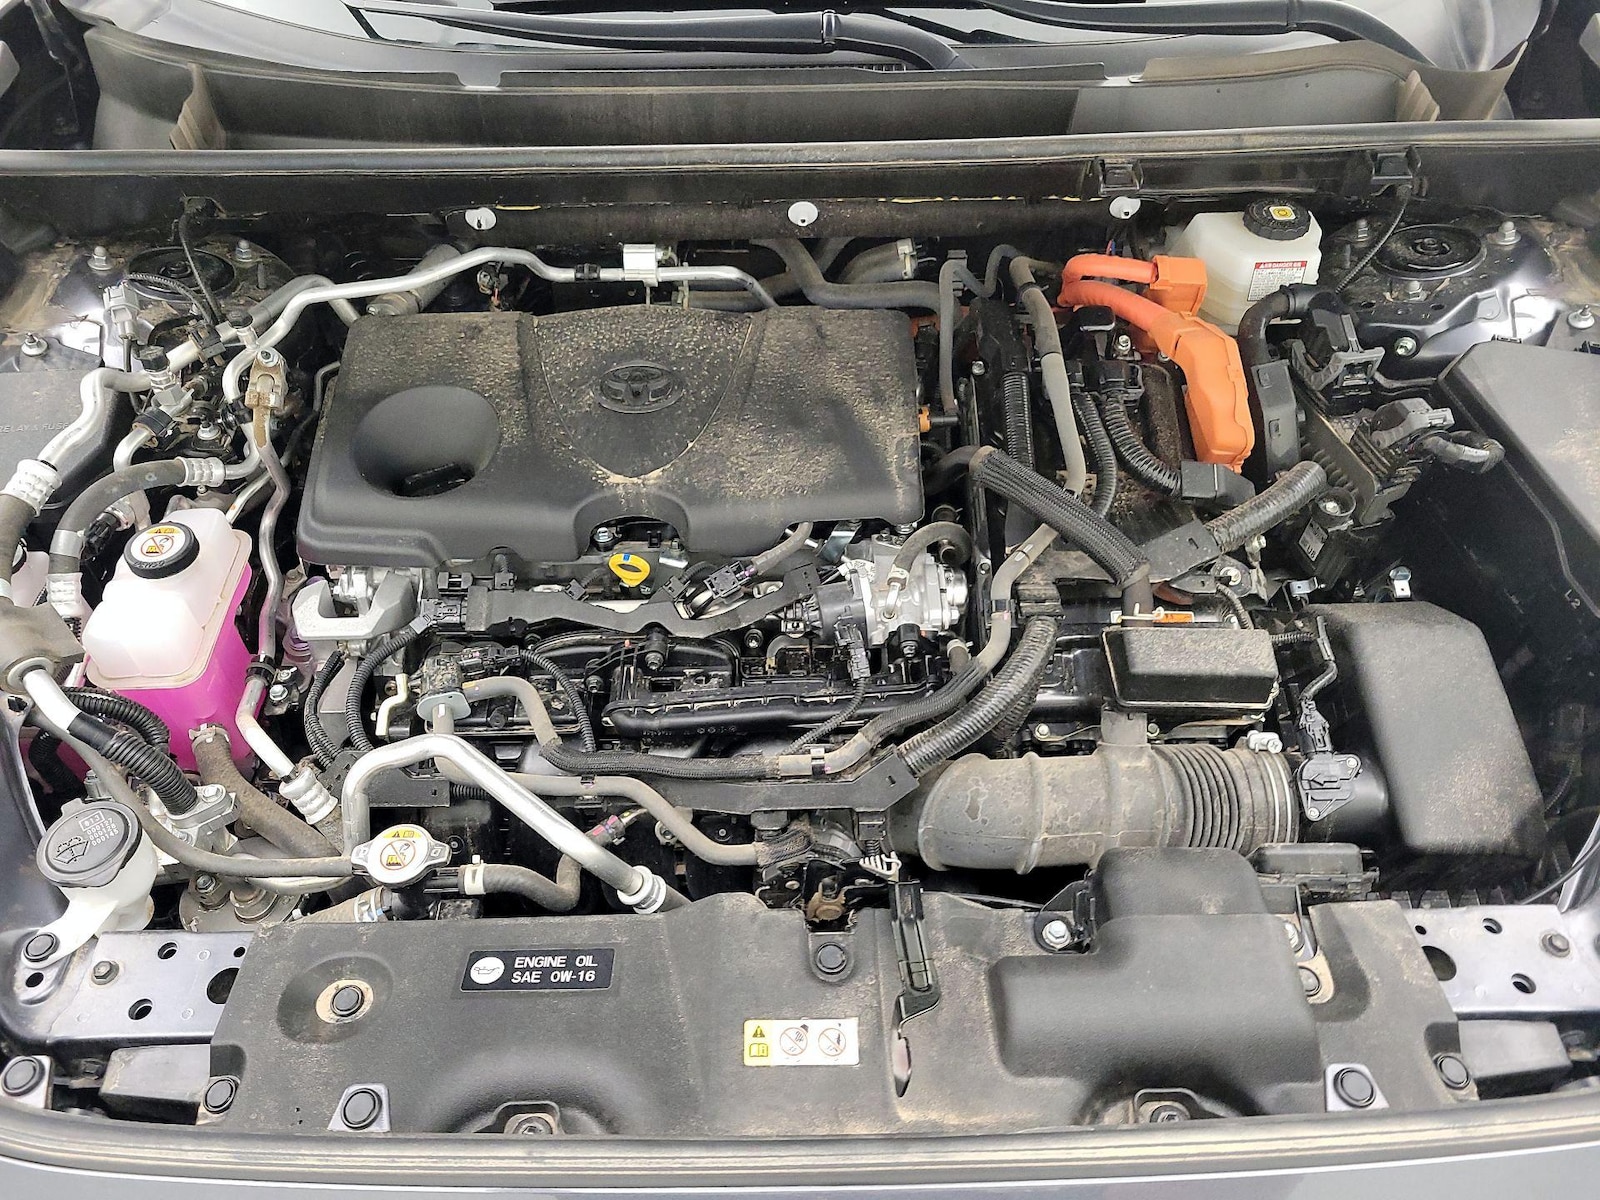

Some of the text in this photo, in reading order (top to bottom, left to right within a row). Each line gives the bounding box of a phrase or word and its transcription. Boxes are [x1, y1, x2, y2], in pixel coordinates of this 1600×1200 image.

[514, 955, 598, 969] ENGINE OIL
[511, 970, 596, 983] SAE 0W-16
